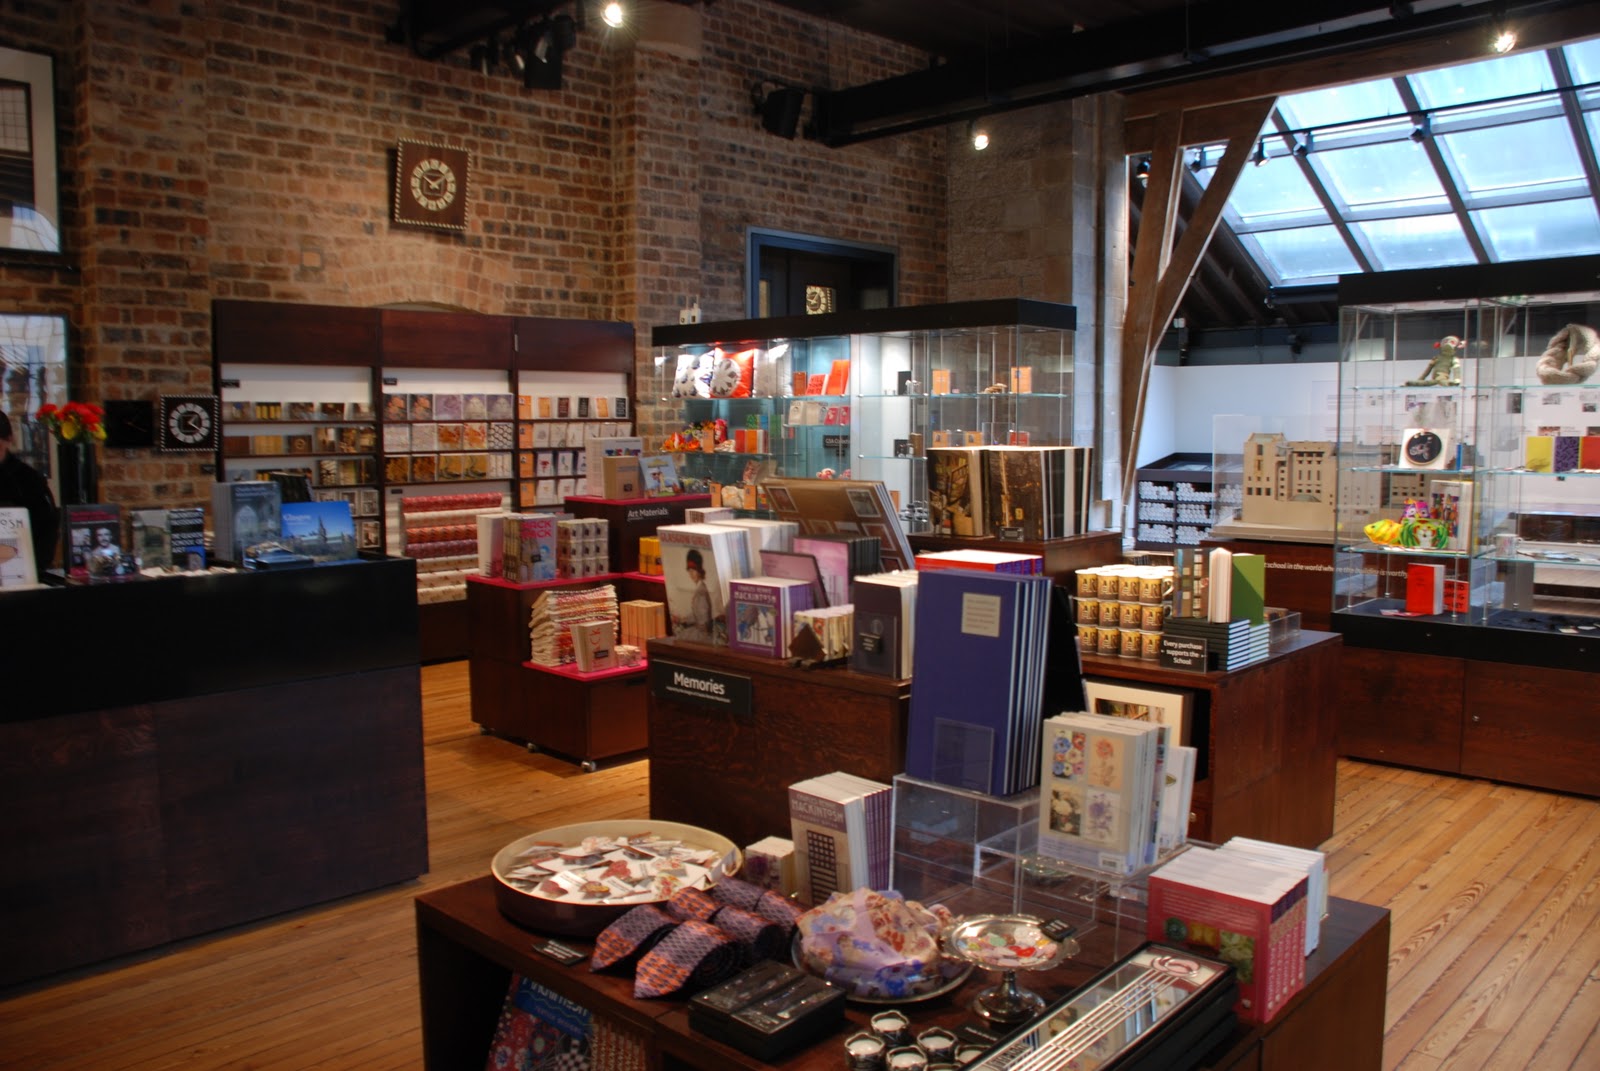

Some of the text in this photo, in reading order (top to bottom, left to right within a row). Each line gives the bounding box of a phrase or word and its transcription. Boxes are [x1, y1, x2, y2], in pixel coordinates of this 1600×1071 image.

[627, 507, 668, 518] Art Materials
[0, 519, 24, 529] OSH
[1268, 561, 1287, 569] school
[734, 591, 777, 603] MACKINTOSH
[1163, 640, 1203, 650] Every purchase
[1166, 649, 1200, 658] supports the
[1173, 656, 1192, 665] School
[673, 671, 725, 695] Memories
[791, 799, 844, 824] MACKINTOSH
